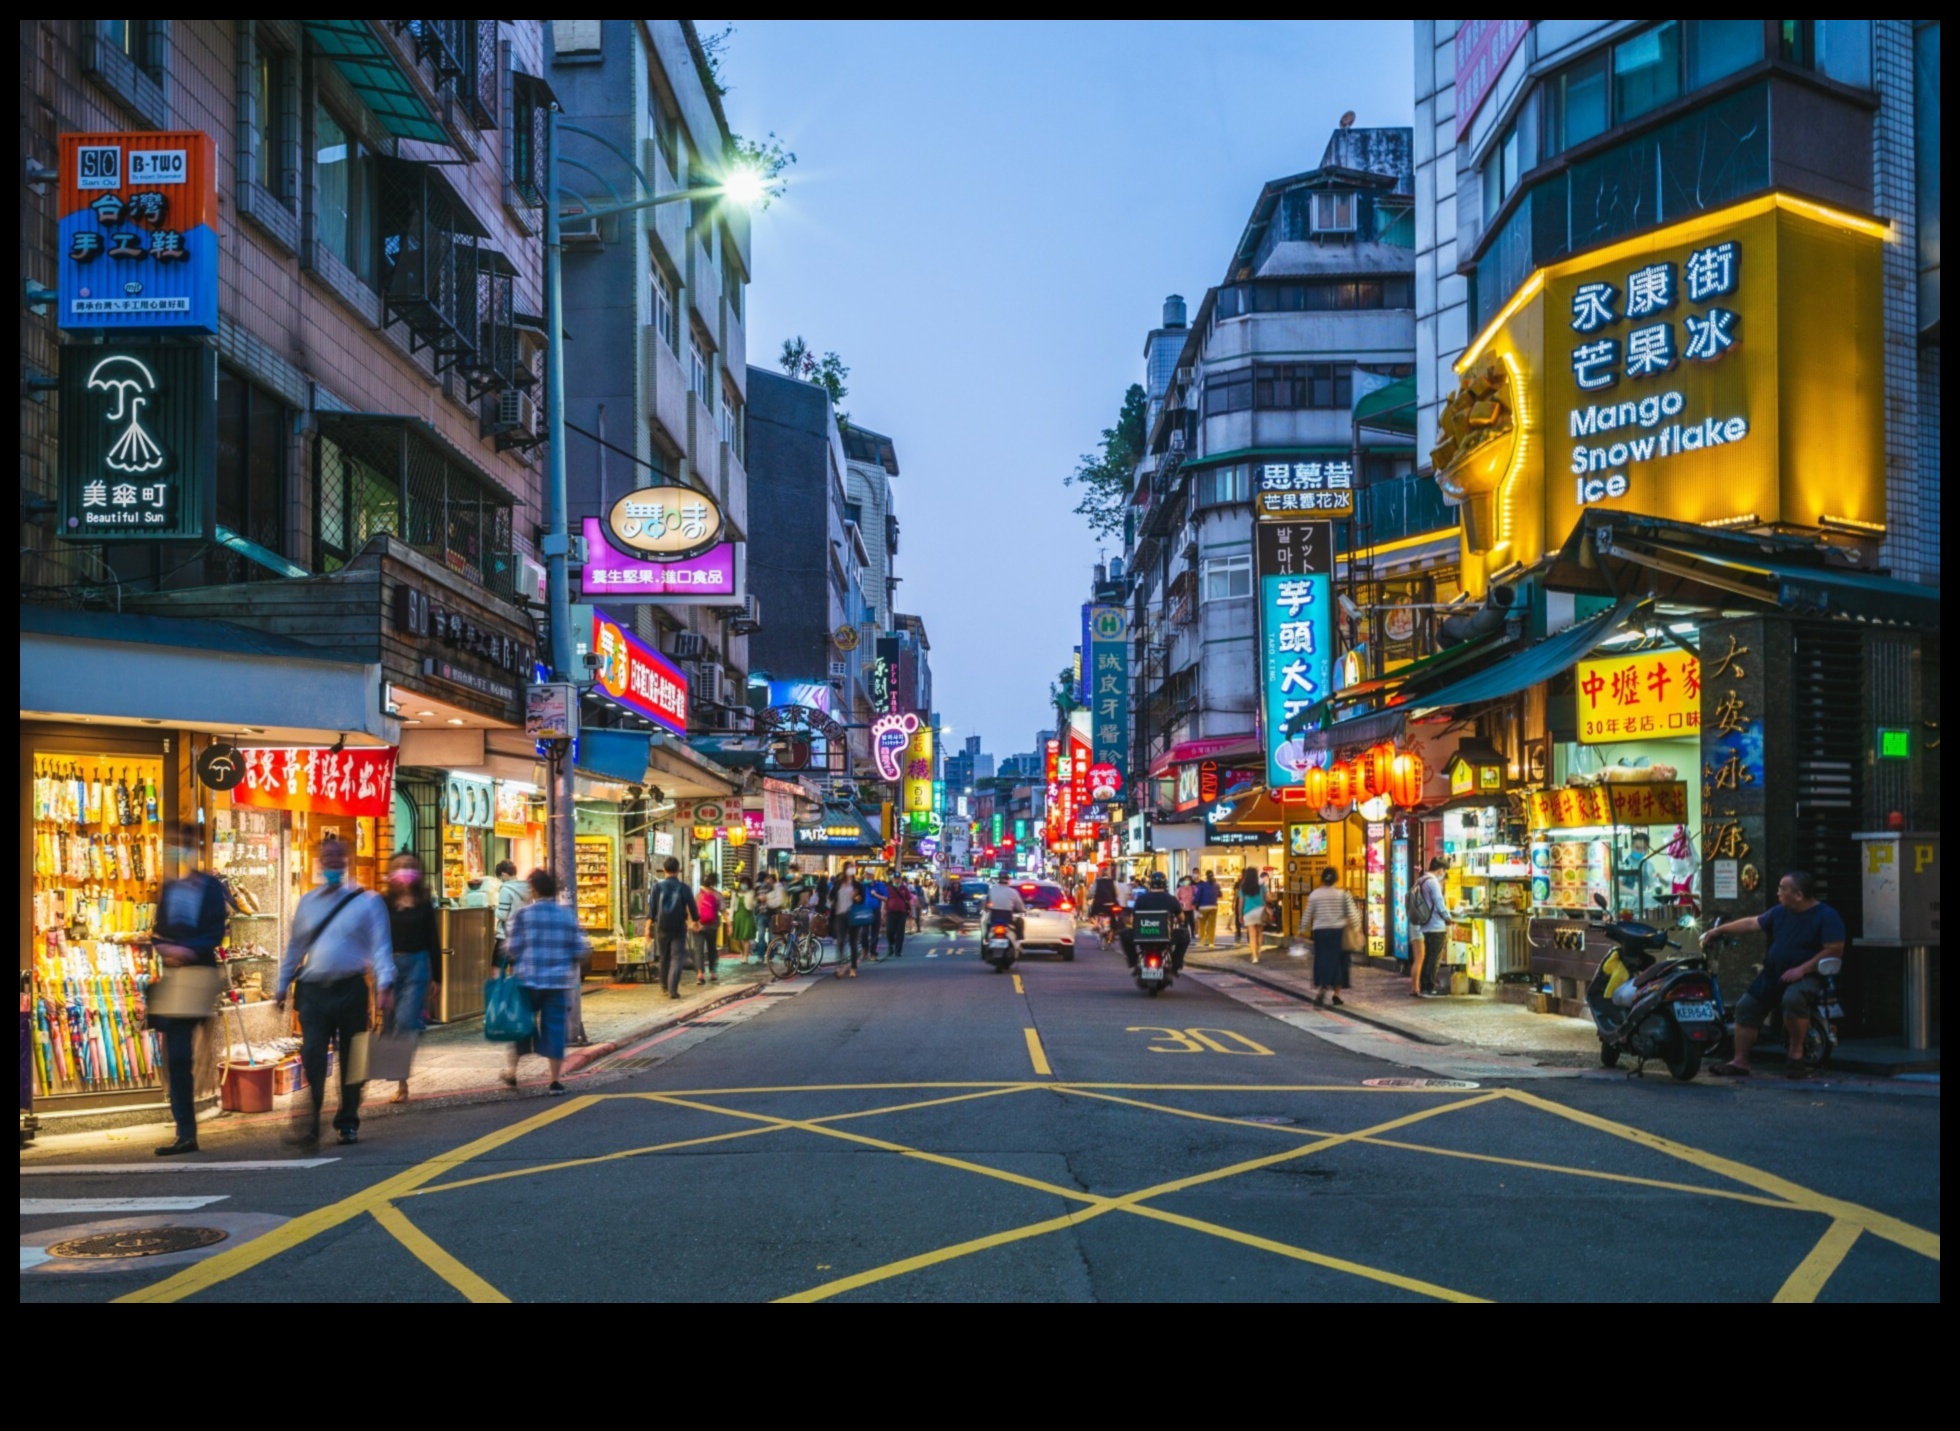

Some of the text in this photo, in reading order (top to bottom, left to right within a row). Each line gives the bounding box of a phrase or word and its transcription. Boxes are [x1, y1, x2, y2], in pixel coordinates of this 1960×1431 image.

[132, 155, 182, 173] B-TWO
[91, 193, 163, 223] 台灣
[70, 230, 184, 260] 手工鞋
[1571, 242, 1733, 330] 永康街
[1572, 308, 1733, 388] 芒果冰
[1570, 391, 1684, 438] Mango
[1571, 416, 1748, 475] Snowflake
[1261, 462, 1354, 490] 思慕昔
[1576, 474, 1628, 505] Ice
[83, 480, 167, 508] 美傘町
[86, 511, 164, 523] Beautiful Sun
[1268, 659, 1277, 682] KING
[890, 663, 898, 715] Pro Tas
[1867, 844, 1894, 874] P
[1914, 844, 1934, 874] P
[1140, 919, 1160, 927] Uber
[1140, 927, 1160, 935] Eats
[1126, 1026, 1276, 1056] 30
